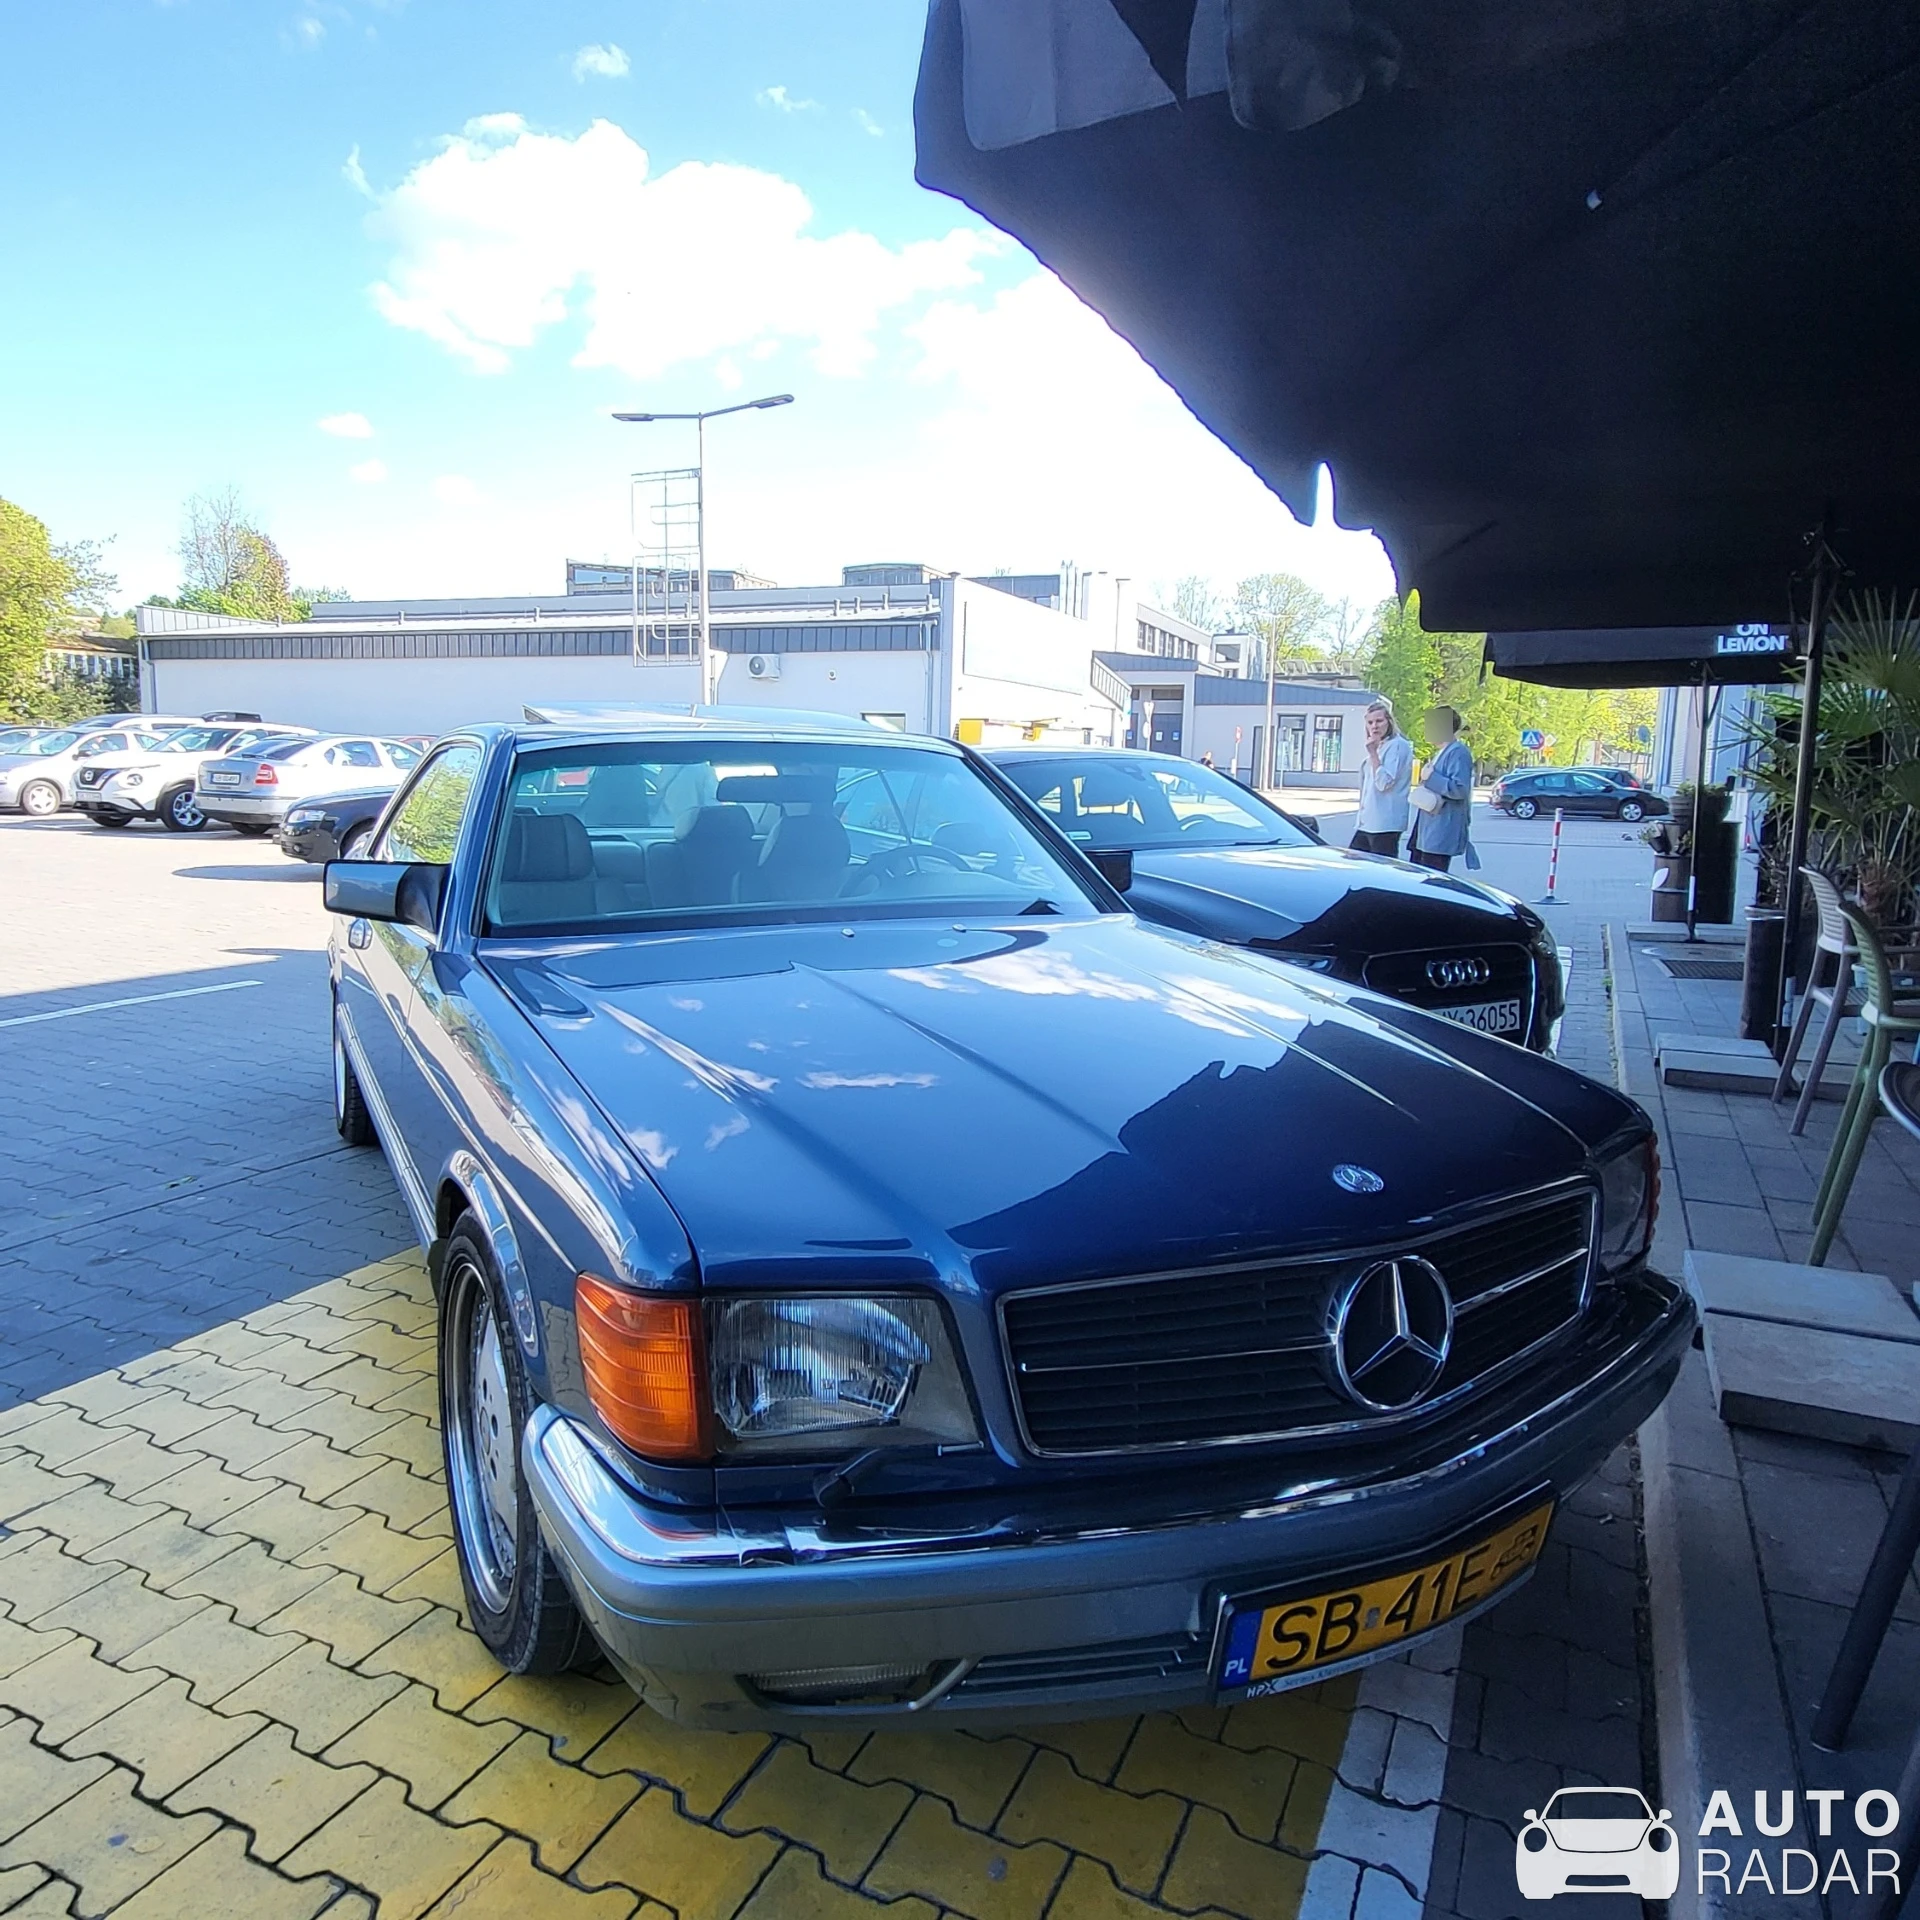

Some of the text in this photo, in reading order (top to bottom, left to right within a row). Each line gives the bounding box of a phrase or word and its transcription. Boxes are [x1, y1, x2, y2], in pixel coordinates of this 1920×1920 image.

[1717, 635, 1785, 653] LEMON
[1466, 1003, 1518, 1031] 36055
[1266, 1593, 1362, 1668] SB
[1384, 1544, 1491, 1633] 41E
[1225, 1658, 1248, 1677] PL
